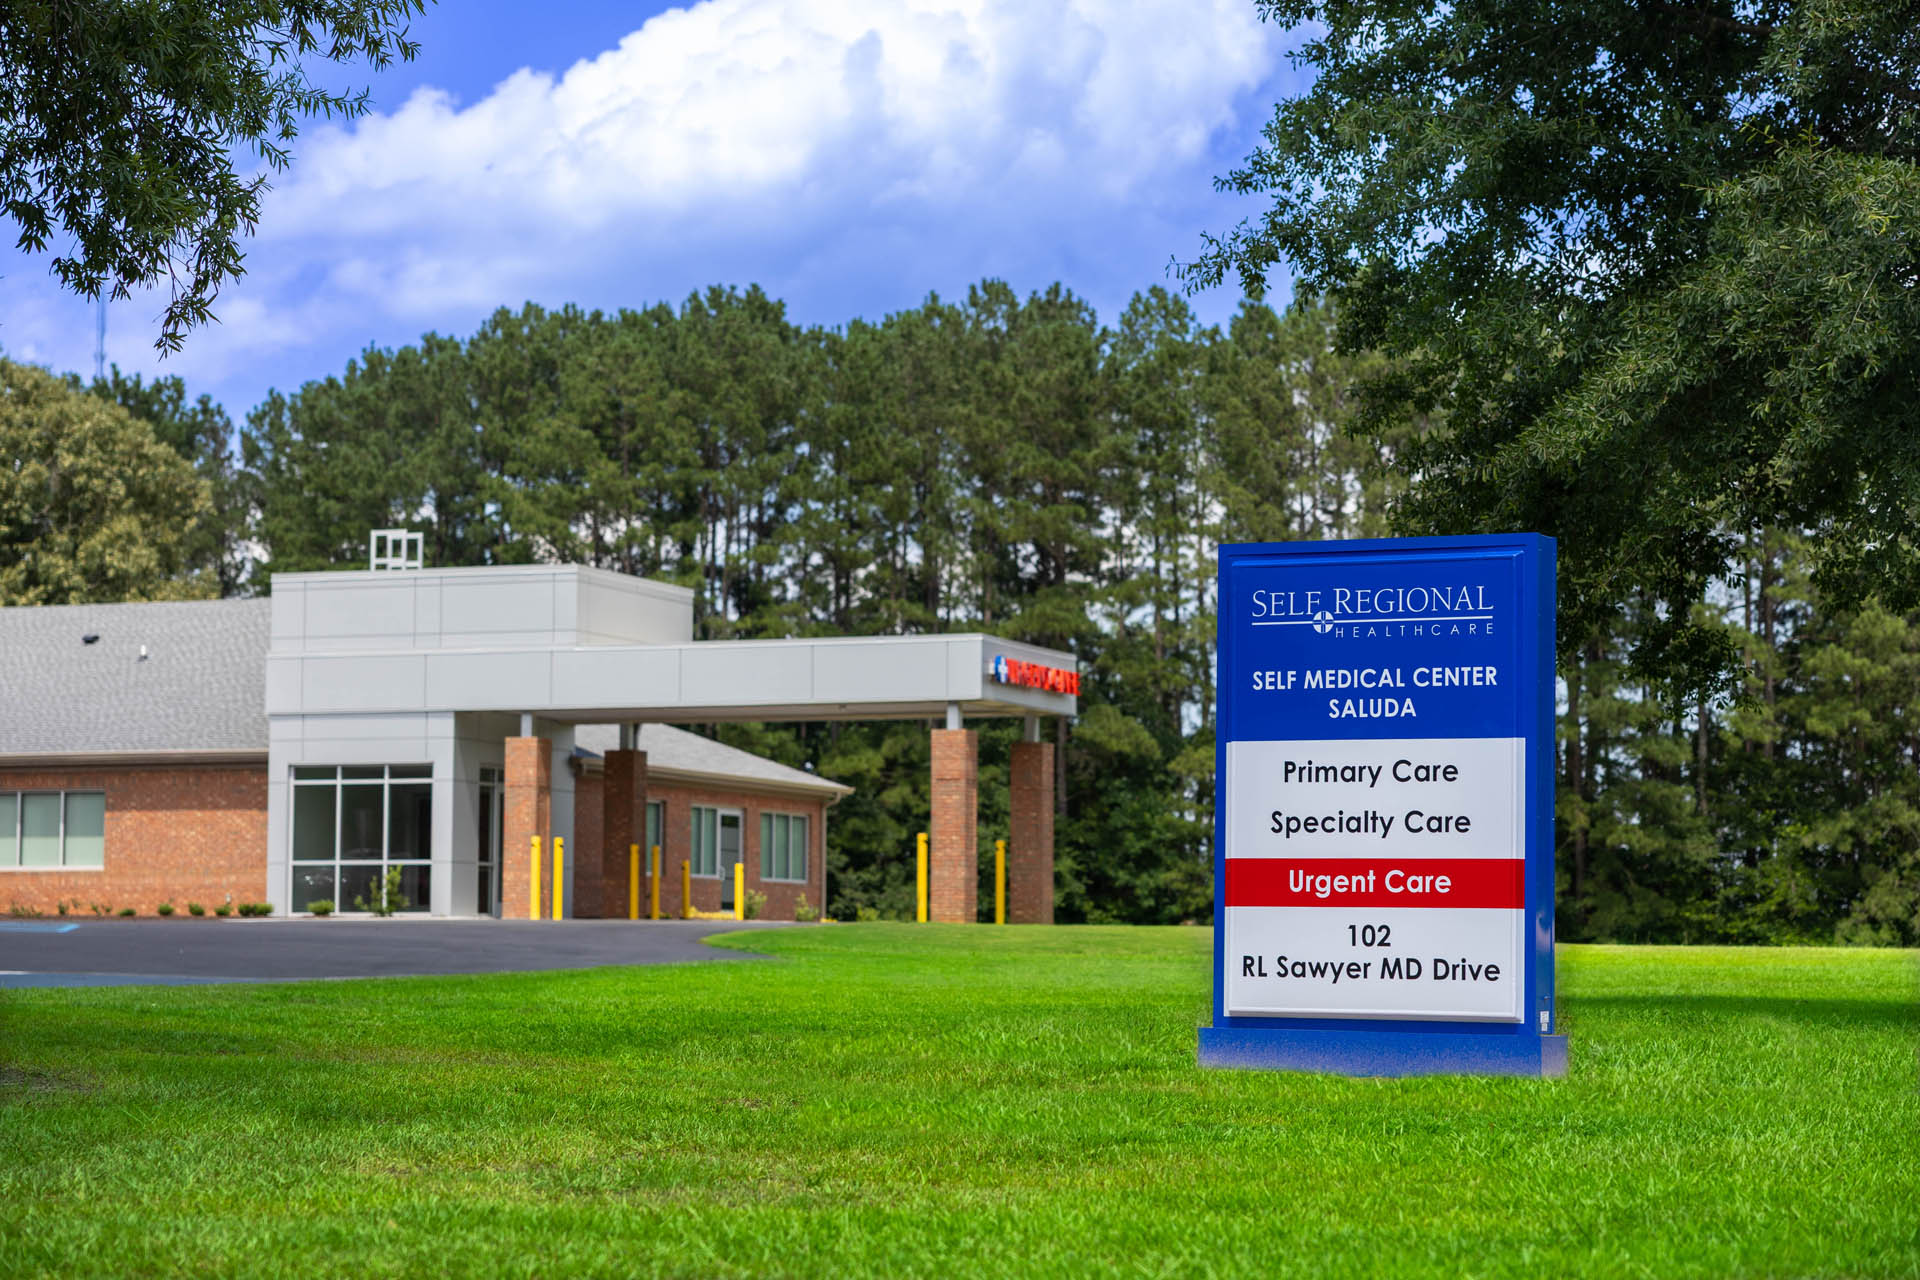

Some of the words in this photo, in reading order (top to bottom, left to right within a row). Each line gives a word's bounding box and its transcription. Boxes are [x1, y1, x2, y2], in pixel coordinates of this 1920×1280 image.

[1252, 590, 1322, 617] SELF
[1333, 585, 1494, 615] REGIONAL
[1335, 622, 1494, 638] HEALTHCARE
[1252, 670, 1297, 690] SELF
[1304, 668, 1405, 689] MEDICAL
[1413, 666, 1497, 686] CENTER
[1328, 698, 1417, 718] SALUDA
[1283, 760, 1382, 788] Primary
[1392, 759, 1459, 783] Care
[1270, 810, 1395, 839] Specialty
[1404, 810, 1471, 834] Care
[1289, 869, 1376, 898] Urgent
[1384, 869, 1452, 894] Care
[1347, 924, 1391, 947] 102
[1242, 955, 1268, 978] RL
[1276, 955, 1372, 984] Sawyer
[1380, 957, 1422, 980] MD
[1433, 959, 1501, 982] Drive
